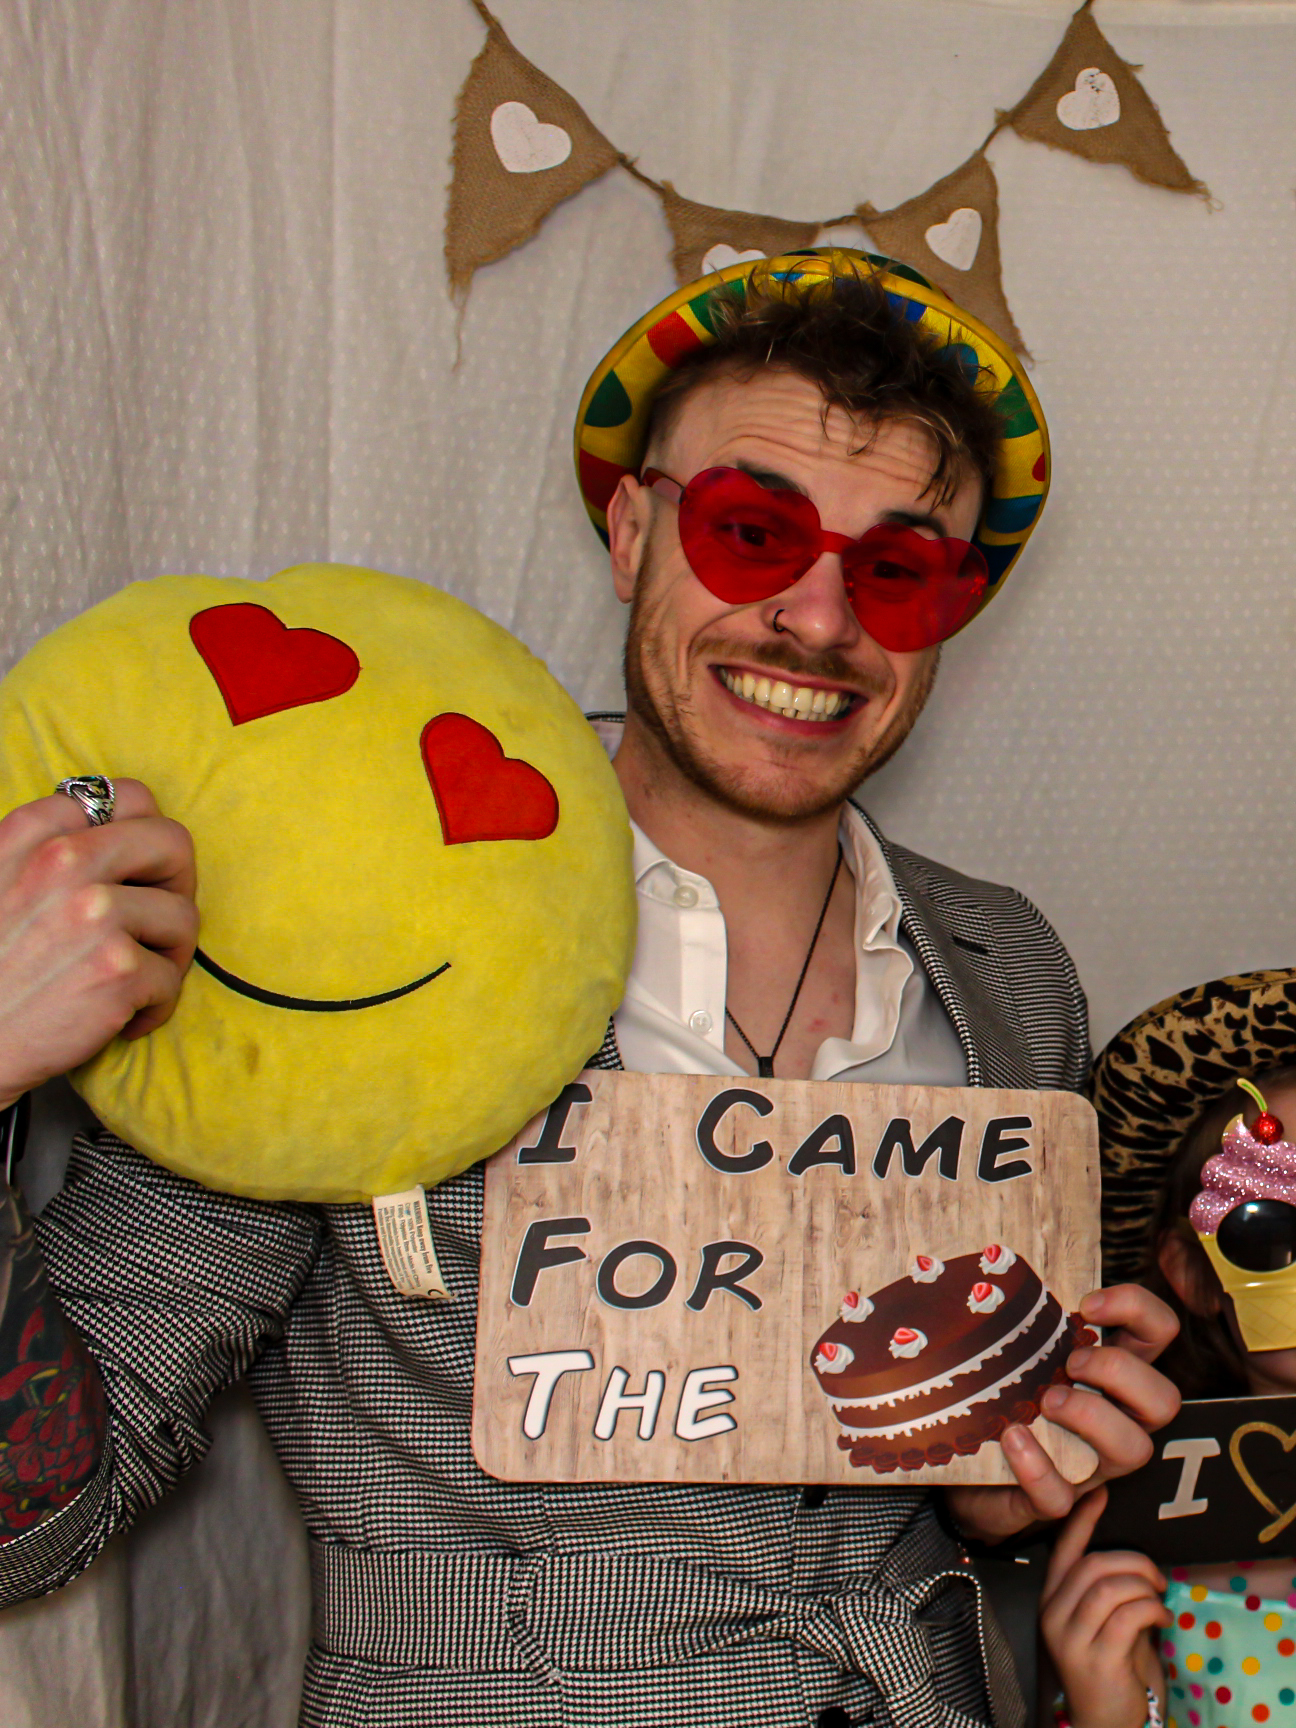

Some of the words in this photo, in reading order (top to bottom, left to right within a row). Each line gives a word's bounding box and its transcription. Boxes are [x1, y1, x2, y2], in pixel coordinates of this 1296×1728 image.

[517, 1082, 593, 1165] I
[697, 1088, 1033, 1183] CAME
[509, 1217, 764, 1312] FOR
[507, 1349, 739, 1443] THE
[1158, 1437, 1221, 1520] I
